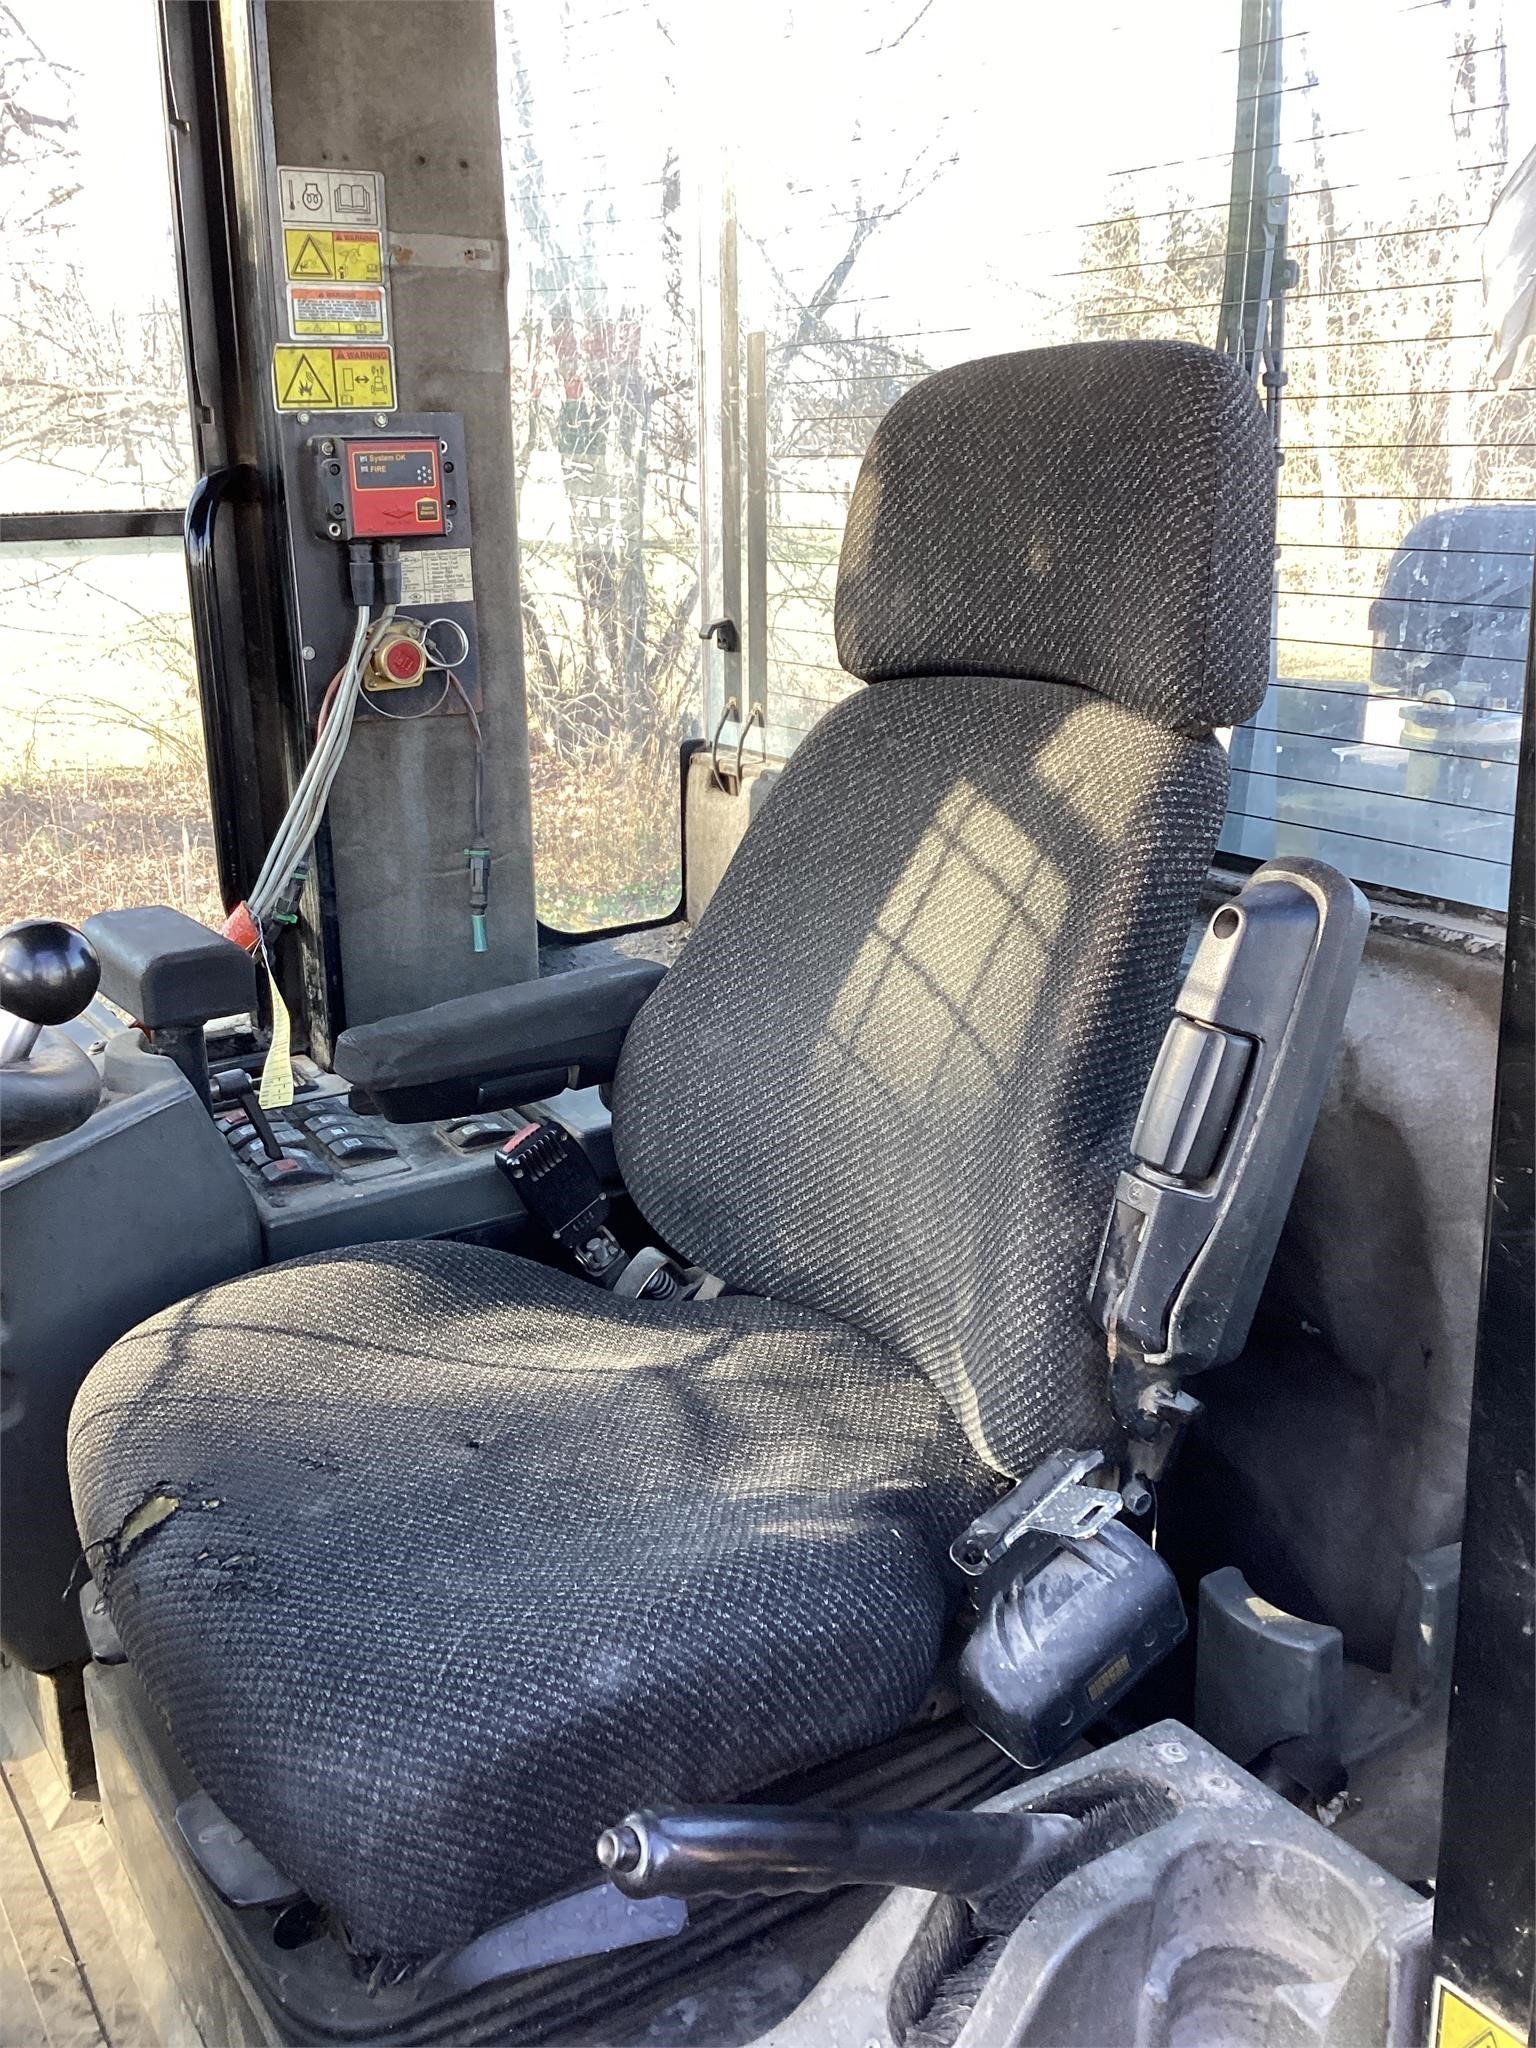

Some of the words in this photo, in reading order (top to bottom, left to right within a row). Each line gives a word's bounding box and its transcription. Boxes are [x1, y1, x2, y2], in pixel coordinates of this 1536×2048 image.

[344, 234, 377, 242] WARNING
[347, 351, 387, 360] WARNING
[369, 454, 394, 463] System
[370, 465, 387, 473] FIRE
